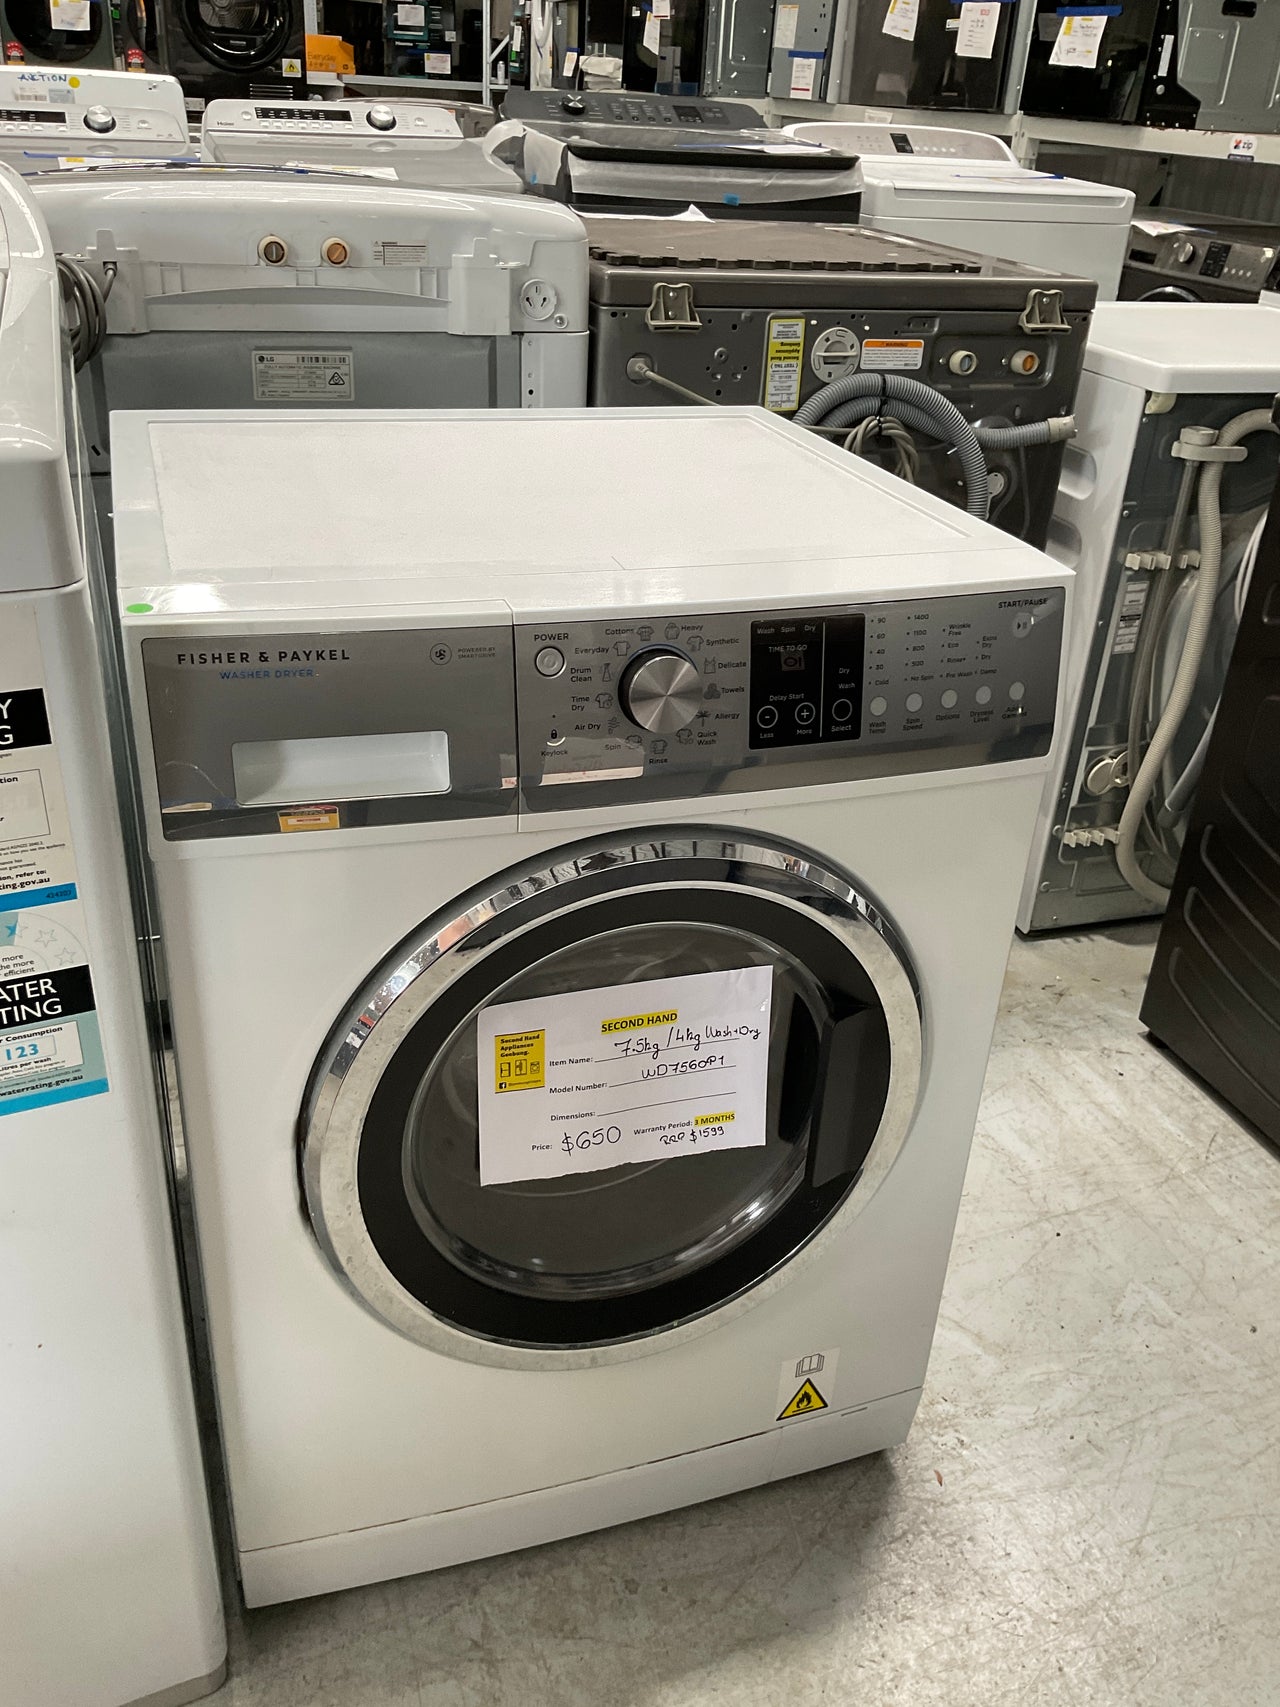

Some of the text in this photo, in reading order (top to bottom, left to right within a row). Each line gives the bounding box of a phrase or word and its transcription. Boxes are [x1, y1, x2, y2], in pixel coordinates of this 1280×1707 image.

[1242, 140, 1253, 151] zip
[998, 598, 1048, 609] START/PAUSE
[681, 624, 704, 632] Heavy
[533, 633, 569, 642] POWER
[705, 637, 740, 646] Synthetic
[574, 646, 610, 655] Everyday
[177, 649, 351, 665] FISHER & PAYKEL
[718, 660, 747, 669] Delicate
[219, 668, 314, 680] WASHER DRYER
[570, 667, 592, 675] Drum
[570, 675, 593, 683] Clean
[721, 686, 745, 694] Towels
[769, 694, 787, 702] Delay
[571, 704, 585, 712] Dry
[714, 712, 740, 720] Allergy
[935, 713, 960, 721] Options
[969, 709, 994, 717] Dryness
[587, 723, 601, 731] Dry
[697, 731, 717, 739] Quick
[697, 738, 716, 746] Wash
[605, 743, 622, 751] Spin
[541, 749, 568, 757] Keylock
[2, 954, 24, 963] more
[13, 960, 35, 968] more
[3, 967, 36, 977] efficient
[601, 1012, 678, 1033] SECOND HAND
[5, 1026, 63, 1042] Consumption
[500, 1036, 523, 1044] Second
[500, 1043, 534, 1051] Appliances
[614, 1038, 660, 1060] 7.5kg
[6, 1043, 39, 1061] 123
[549, 1055, 594, 1067] Item Name:
[549, 1081, 608, 1095] Model Number:
[550, 1110, 596, 1121] Dimensions:
[633, 1125, 666, 1136] Warranty
[667, 1120, 693, 1131] Period:
[700, 1113, 735, 1125] MONTHS
[689, 1126, 725, 1144] $1599
[561, 1125, 622, 1156] $650
[531, 1142, 553, 1152] Price:
